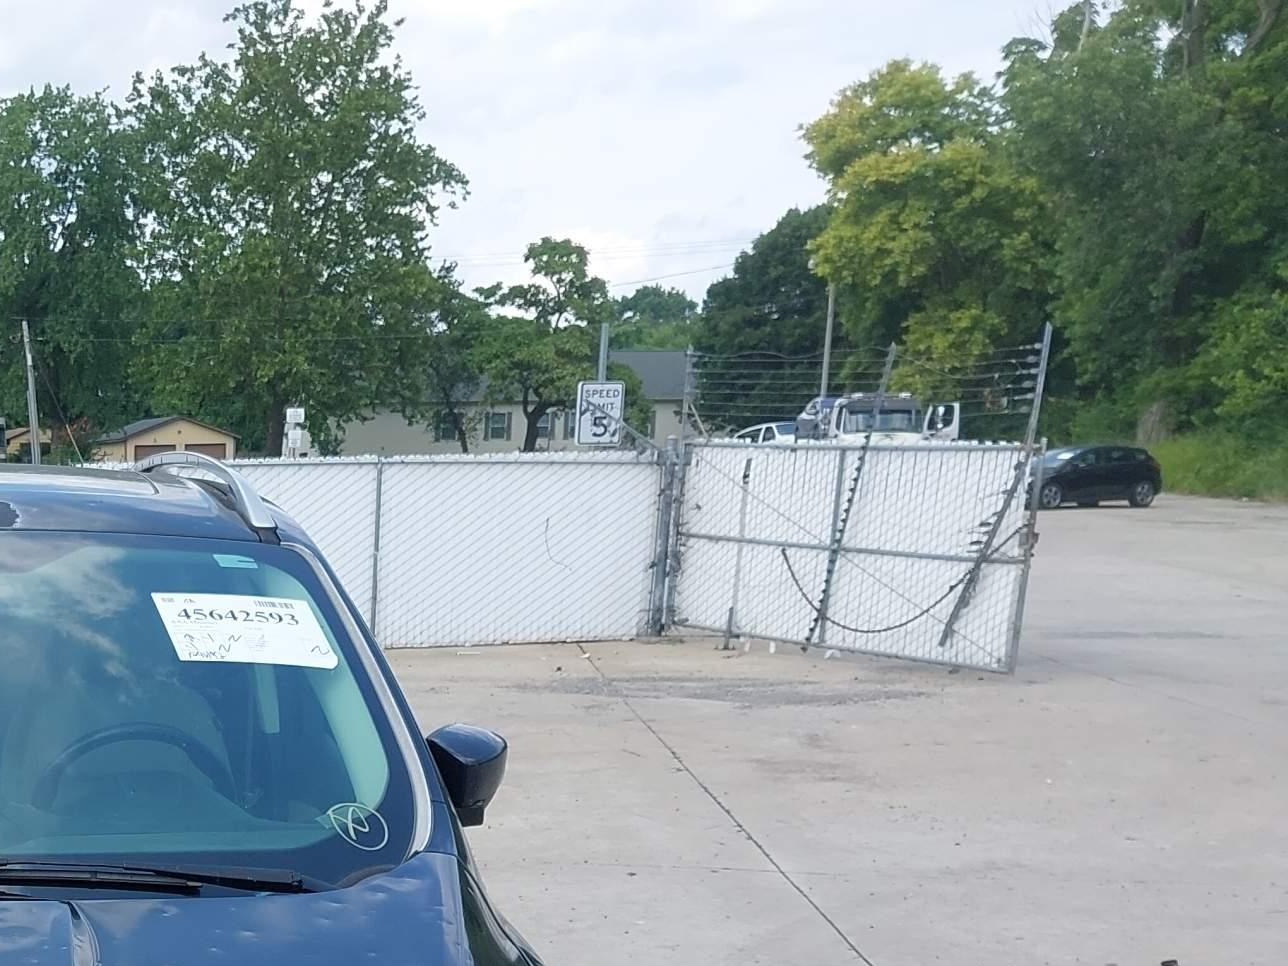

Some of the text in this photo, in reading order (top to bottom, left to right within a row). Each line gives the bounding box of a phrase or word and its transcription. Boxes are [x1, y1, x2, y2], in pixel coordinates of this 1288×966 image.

[585, 389, 620, 399] SPEED
[592, 416, 608, 437] 5
[177, 608, 299, 626] 45642593
